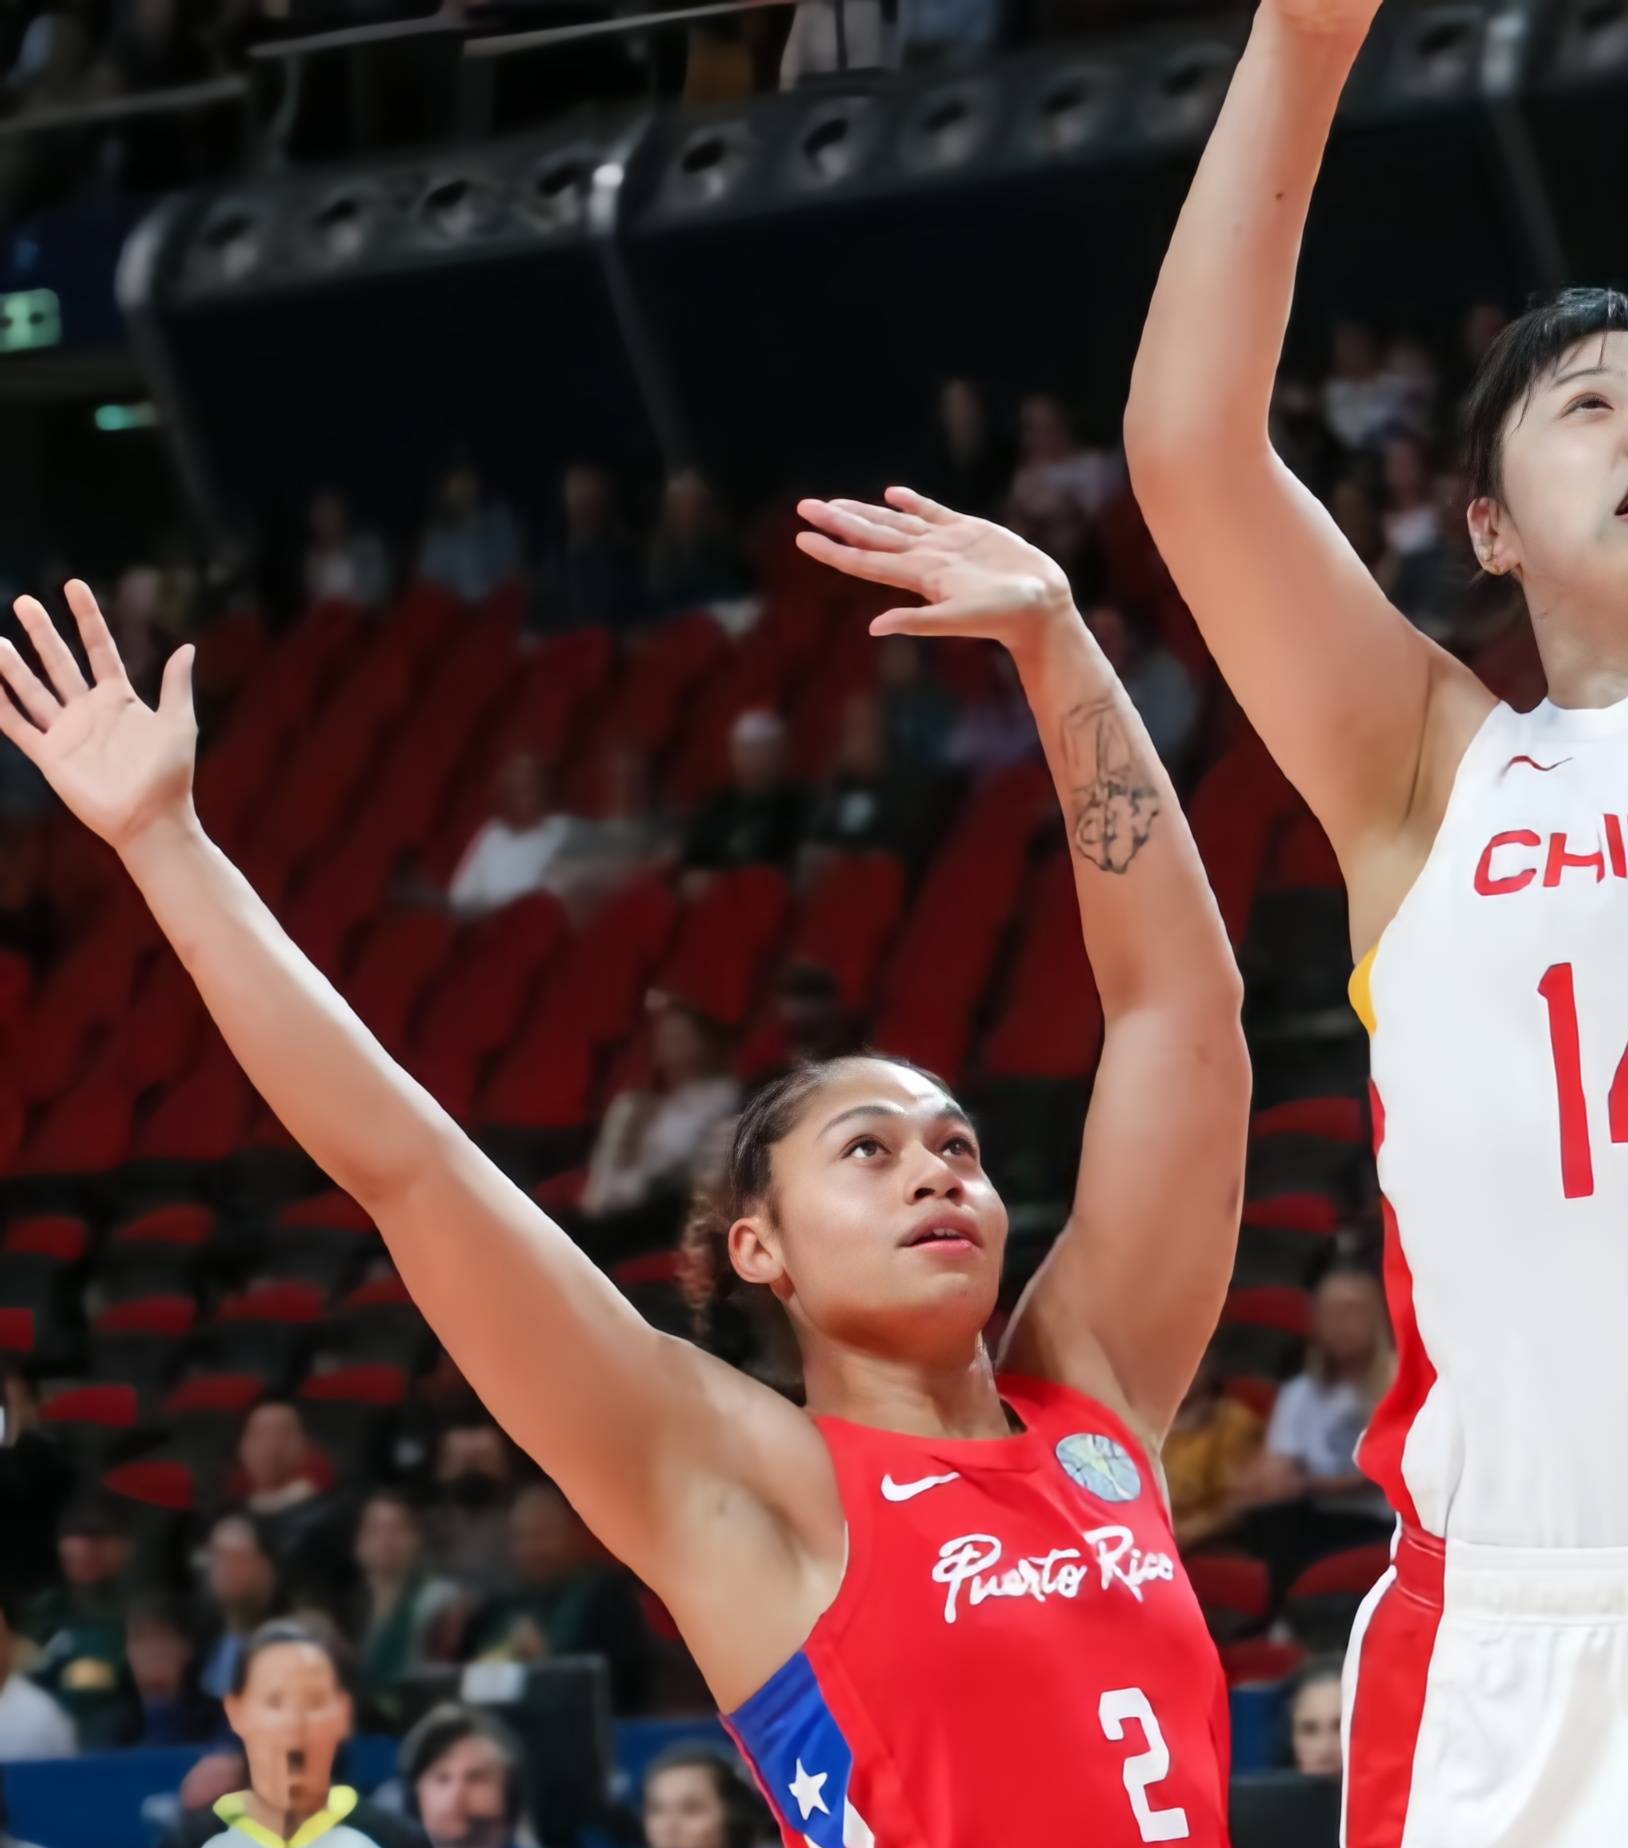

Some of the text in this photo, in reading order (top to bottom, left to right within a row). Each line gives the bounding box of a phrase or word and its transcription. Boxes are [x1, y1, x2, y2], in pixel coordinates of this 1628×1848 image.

[931, 1524, 1175, 1624] Puerto Rico
[1098, 1687, 1191, 1843] 2
